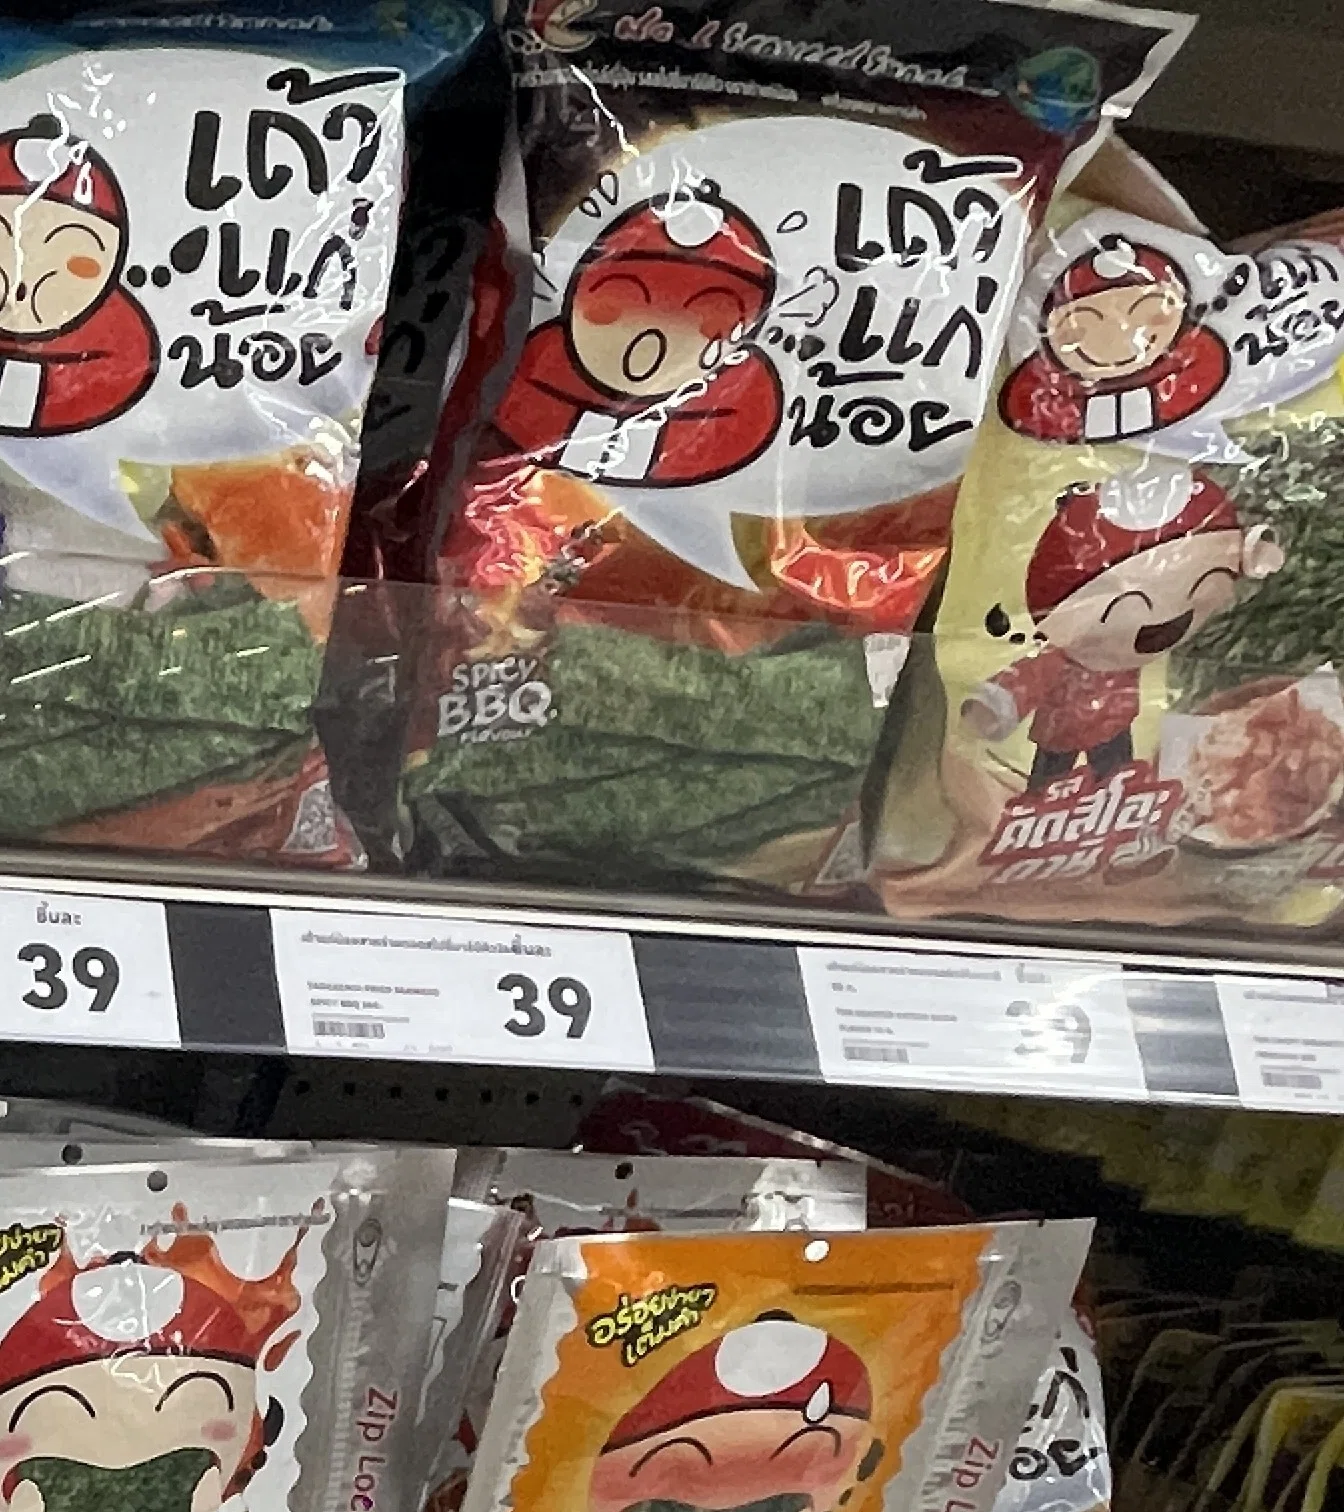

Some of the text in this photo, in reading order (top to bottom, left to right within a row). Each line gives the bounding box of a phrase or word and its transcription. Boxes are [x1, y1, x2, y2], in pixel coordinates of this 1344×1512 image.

[451, 656, 538, 693] SPICY
[16, 941, 122, 1013] 39
[496, 972, 593, 1040] 39
[363, 1385, 399, 1442] Zip
[948, 1433, 1001, 1488] Zip
